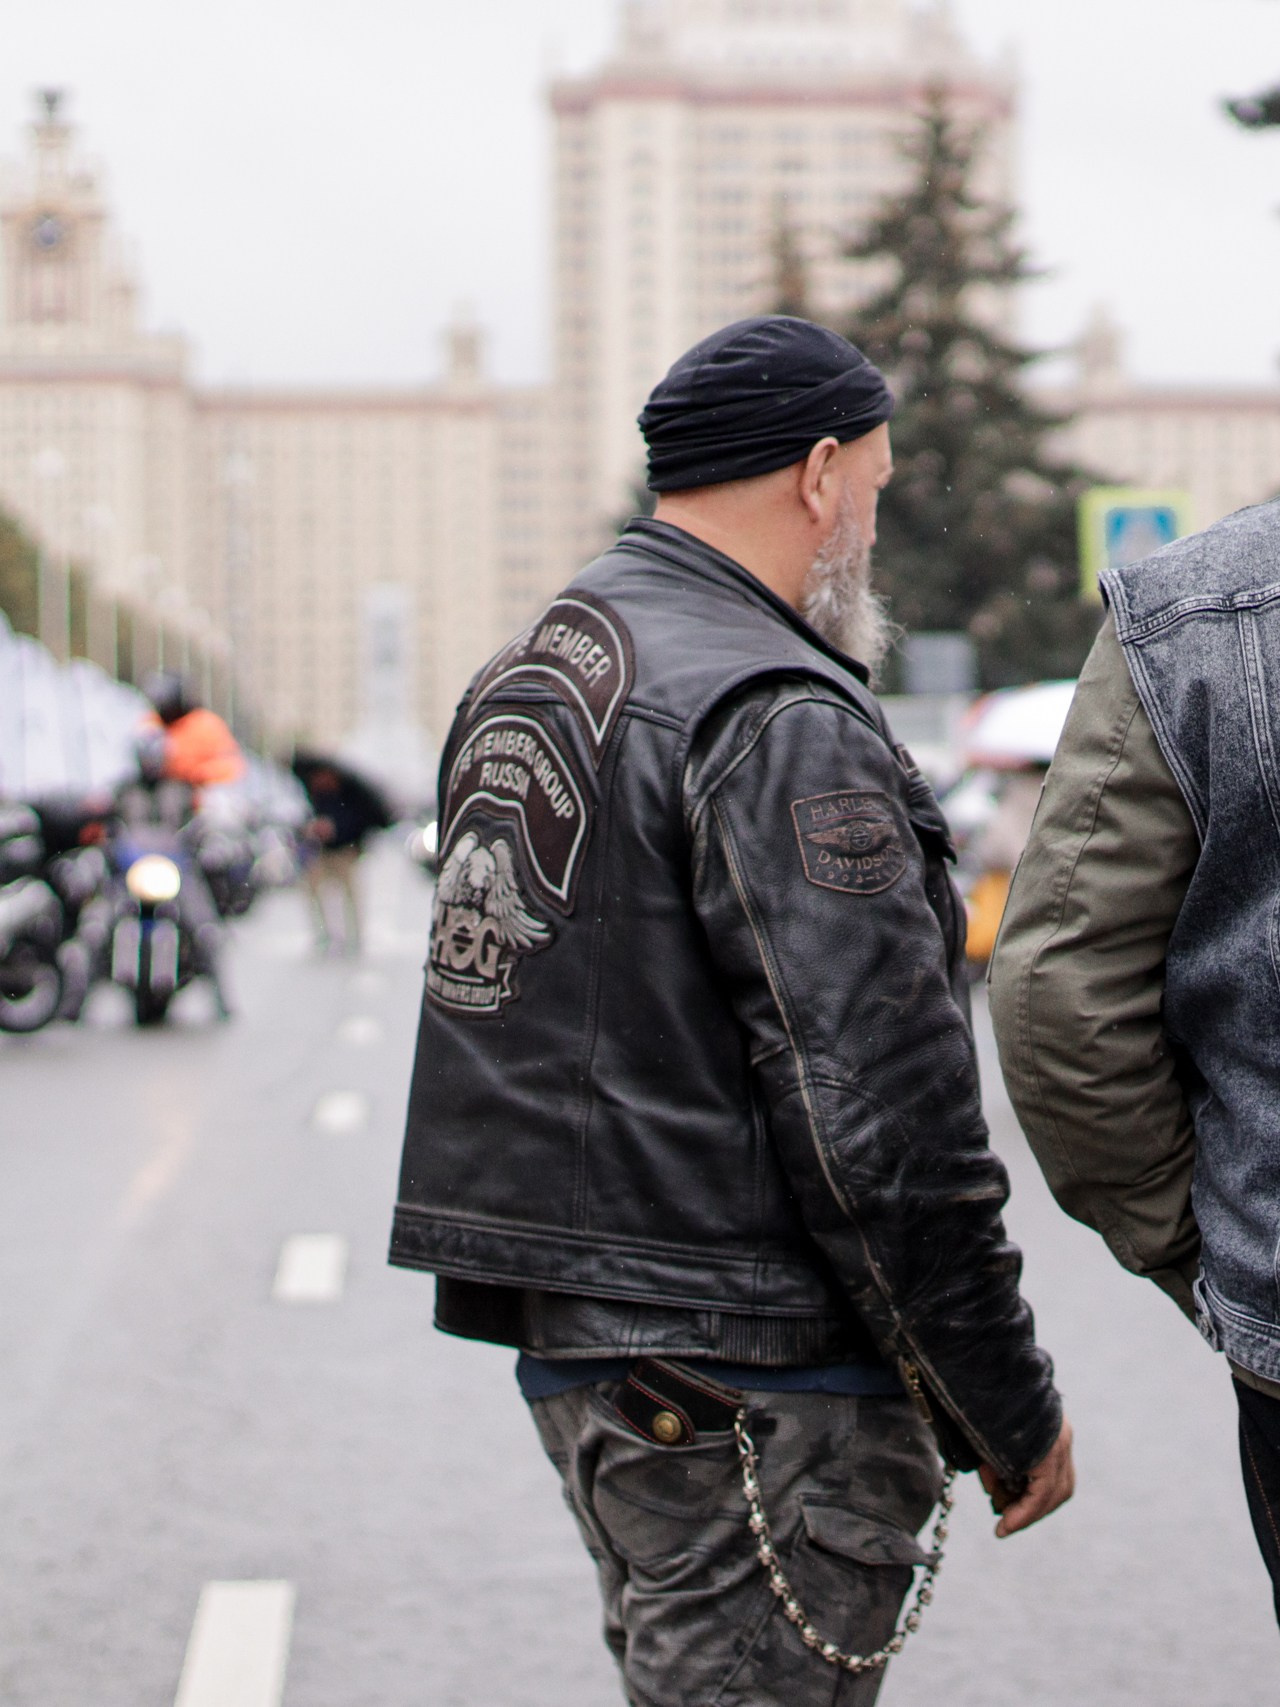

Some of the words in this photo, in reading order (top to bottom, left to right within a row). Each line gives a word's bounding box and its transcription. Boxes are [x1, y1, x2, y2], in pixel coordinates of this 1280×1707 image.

[532, 623, 611, 687] MEMBER
[473, 730, 537, 767] MEMBERS
[533, 749, 576, 819] GROUP
